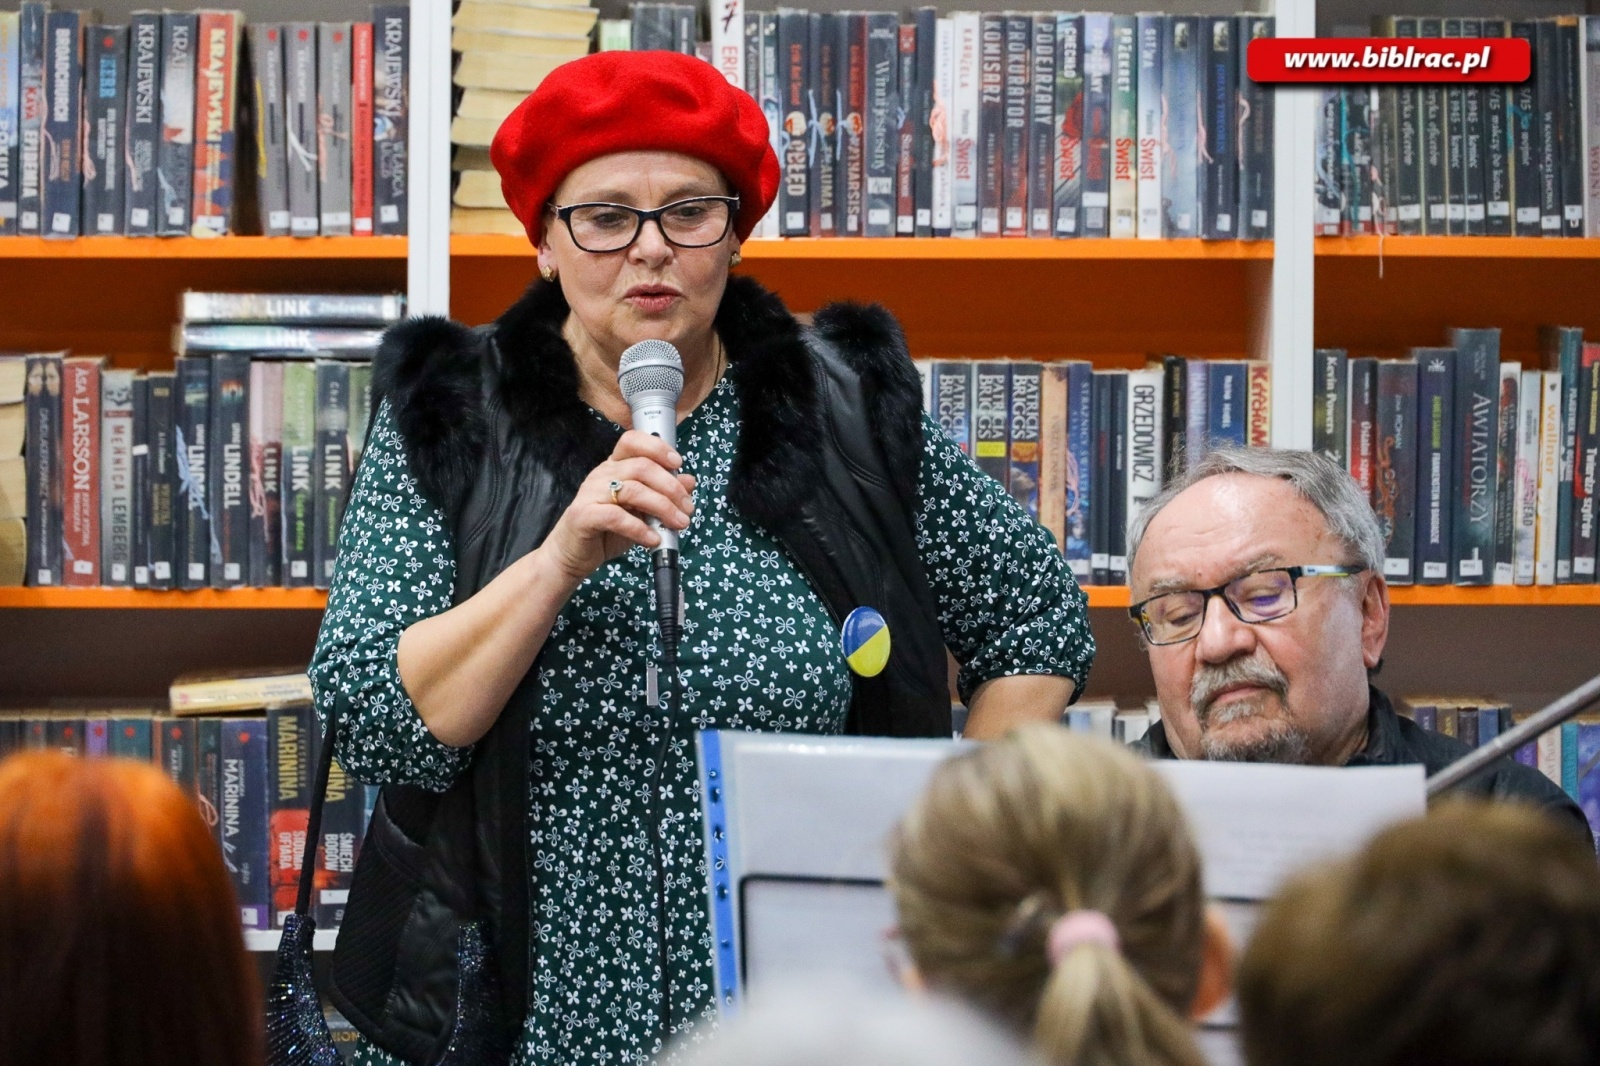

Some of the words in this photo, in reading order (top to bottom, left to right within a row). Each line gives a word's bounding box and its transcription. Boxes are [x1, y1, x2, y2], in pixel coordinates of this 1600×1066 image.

[54, 29, 70, 122] BROADCHURCH
[99, 57, 116, 98] KERR
[136, 24, 154, 123] KRAJEWSKI
[384, 18, 402, 116] KRAJEWSKI
[722, 46, 738, 83] ERIC
[982, 21, 1001, 104] KOMISARZ
[1007, 21, 1025, 128] PROKURATOR
[1035, 23, 1053, 125] PODEJRZANY
[1063, 27, 1077, 78] CHECHŁO
[21, 130, 38, 198] EPIDEMIA
[955, 138, 973, 180] Świst
[1059, 137, 1080, 179] Świst
[1115, 138, 1135, 180] Świst
[1140, 138, 1160, 181] Świst
[266, 299, 311, 316] LINK
[1326, 356, 1337, 390] Kevin
[952, 374, 967, 439] PATRICIA
[977, 374, 992, 439] BRIGGS
[992, 374, 1005, 439] PATRICIA
[1012, 375, 1026, 439] BRIGGS
[1026, 375, 1039, 439] PATRICIA
[1325, 393, 1335, 434] Powers
[72, 397, 90, 491] LARSSON
[1132, 385, 1155, 482] GRZĘDOWICZ
[1360, 421, 1372, 456] Ostatni
[1469, 392, 1491, 525] AWIATORZY
[1545, 404, 1556, 475] wallner
[188, 445, 205, 510] LINDELL
[224, 444, 241, 509] LINDELL
[264, 448, 277, 493] LINK
[292, 445, 309, 491] LINK
[324, 444, 342, 490] LINK
[1431, 453, 1440, 500] FRANKENSTEIN
[1584, 448, 1598, 495] Twierdza
[112, 497, 127, 561] LEMBERG
[1430, 509, 1439, 544] BAGDADZIE
[1581, 497, 1594, 538] szyfrów
[277, 716, 299, 801] MARININA
[324, 758, 345, 802] NINA
[224, 759, 240, 837] MARININA
[279, 832, 293, 870] OFIARA
[324, 833, 340, 871] BOGÓW
[339, 833, 356, 872] ŚMIECH
